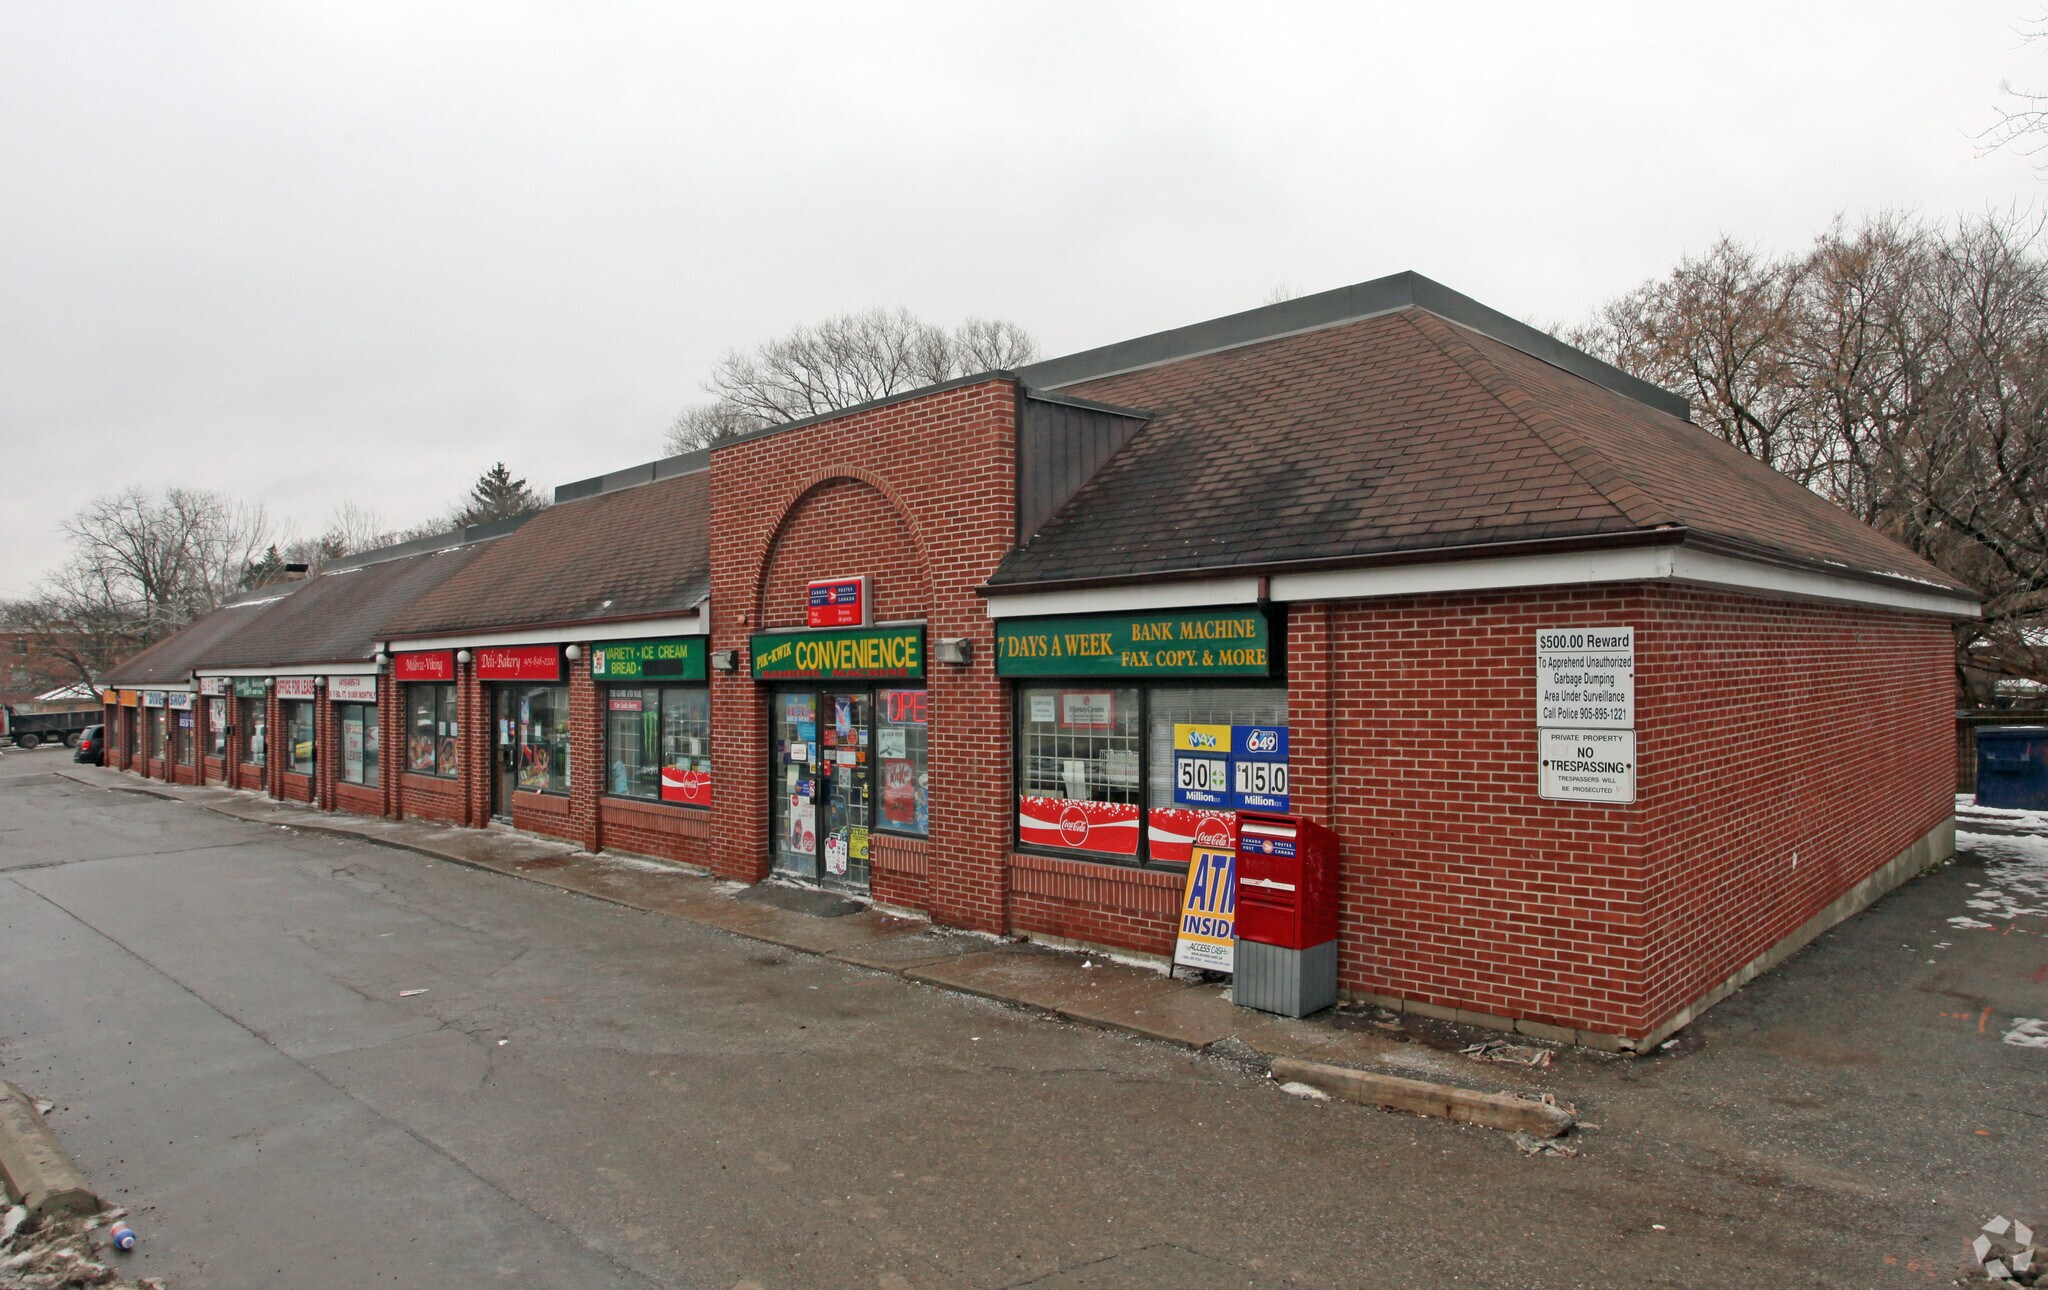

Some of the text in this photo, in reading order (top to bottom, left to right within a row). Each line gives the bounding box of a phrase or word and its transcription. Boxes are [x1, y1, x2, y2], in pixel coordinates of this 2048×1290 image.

[1132, 619, 1256, 641] BANK MACHINE
[998, 633, 1114, 658] 7 DAYS A WEEK
[1540, 634, 1629, 649] $500.00 Reward
[606, 645, 687, 659] VARIETY ICE CREAM
[756, 636, 917, 670] PIK-KWIK CONVENIENCE
[1202, 650, 1214, 666] &
[1218, 649, 1267, 666] MORE
[481, 650, 521, 675] Deli-Bakery
[611, 662, 636, 674] BREAD
[1538, 656, 1631, 671] To Apprehend Unauthorized
[762, 668, 908, 679] BANKING MACHINE
[1554, 672, 1614, 687] Garbage Dumping
[277, 680, 291, 695] OFFICE
[292, 680, 300, 695] FOR
[301, 680, 315, 695] LEASE
[170, 693, 187, 706] SHOP
[1544, 690, 1625, 702] Area Under Surveillance
[890, 692, 927, 722] OPE
[1543, 707, 1626, 720] Call Police 905-895-1221
[1190, 732, 1214, 747] MAX
[346, 751, 362, 762] LEASE
[1578, 747, 1594, 758] NO
[1550, 760, 1624, 773] TRESPASSING
[1186, 791, 1214, 801] Million
[1245, 796, 1274, 806] Million
